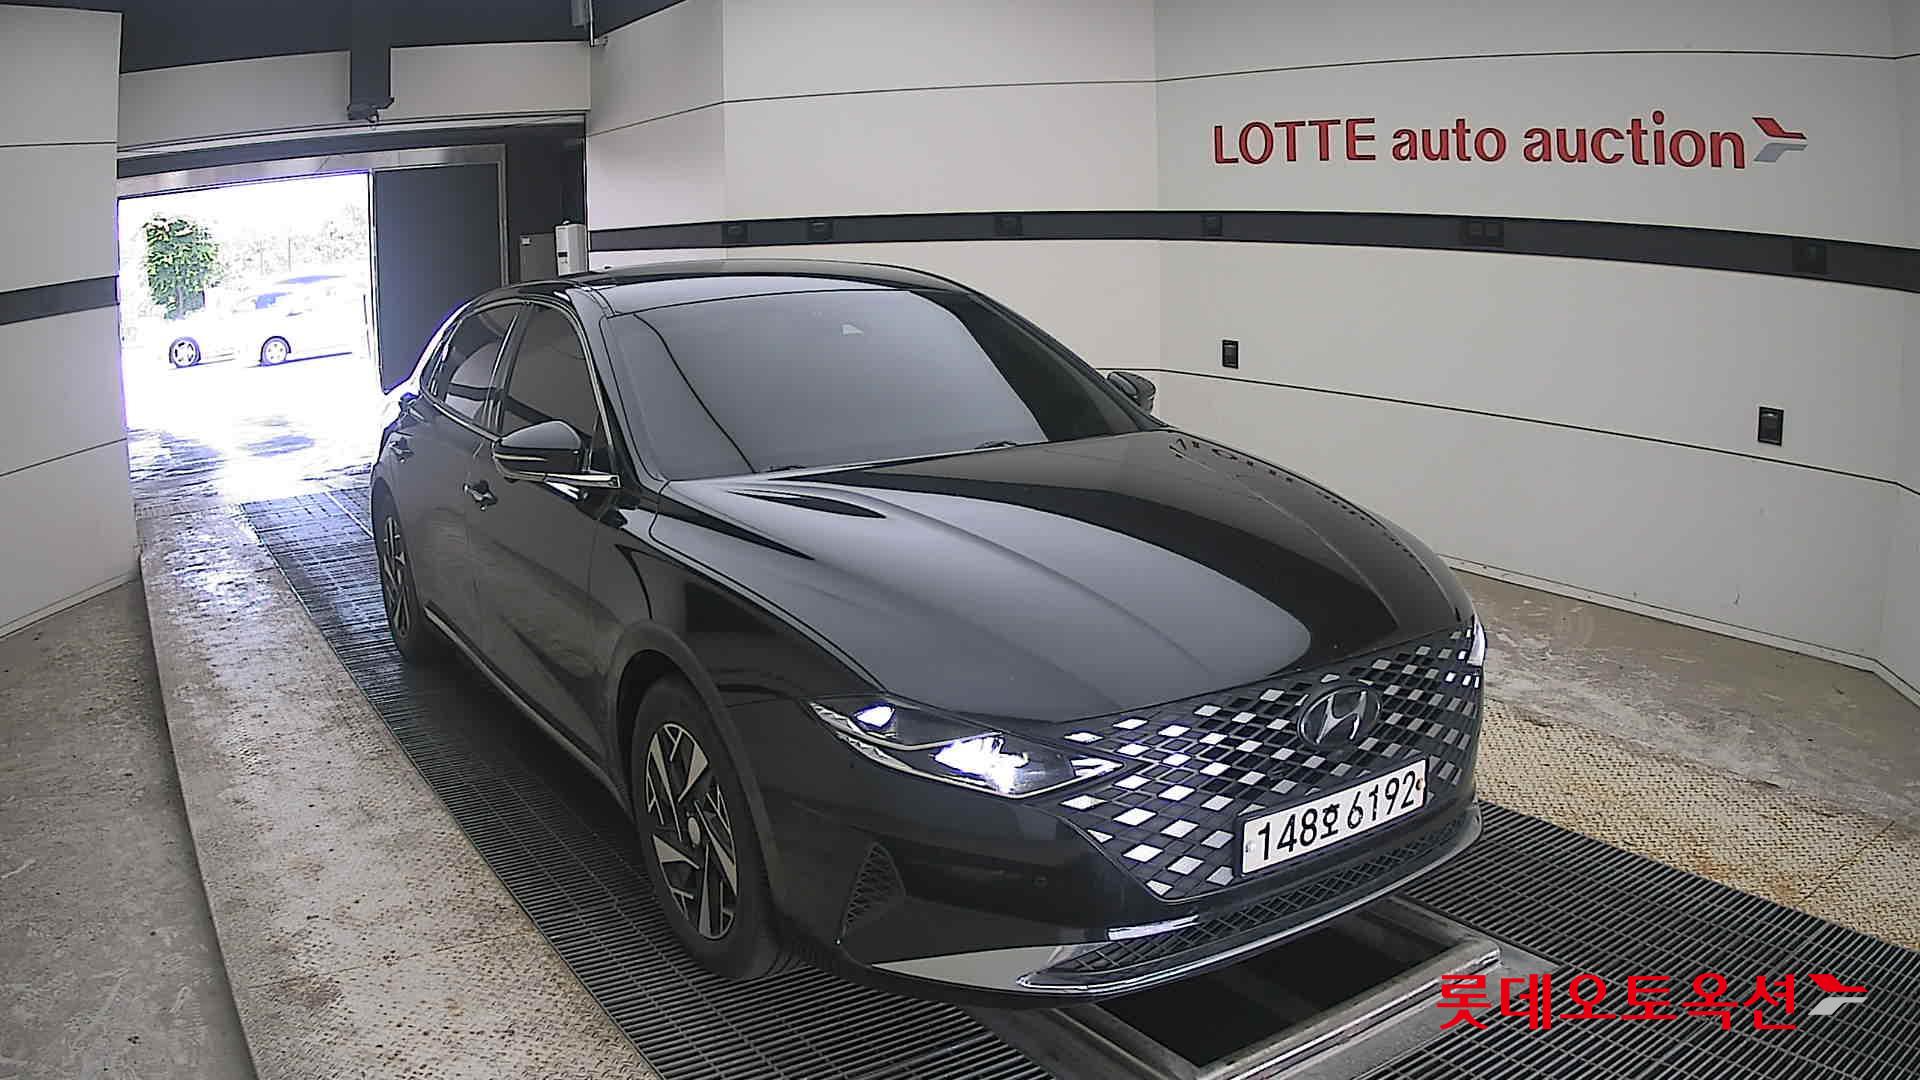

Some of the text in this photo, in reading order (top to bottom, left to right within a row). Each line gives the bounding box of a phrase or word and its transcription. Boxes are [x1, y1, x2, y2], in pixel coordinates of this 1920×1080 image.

[1214, 111, 1746, 169] LOTTE auto auction
